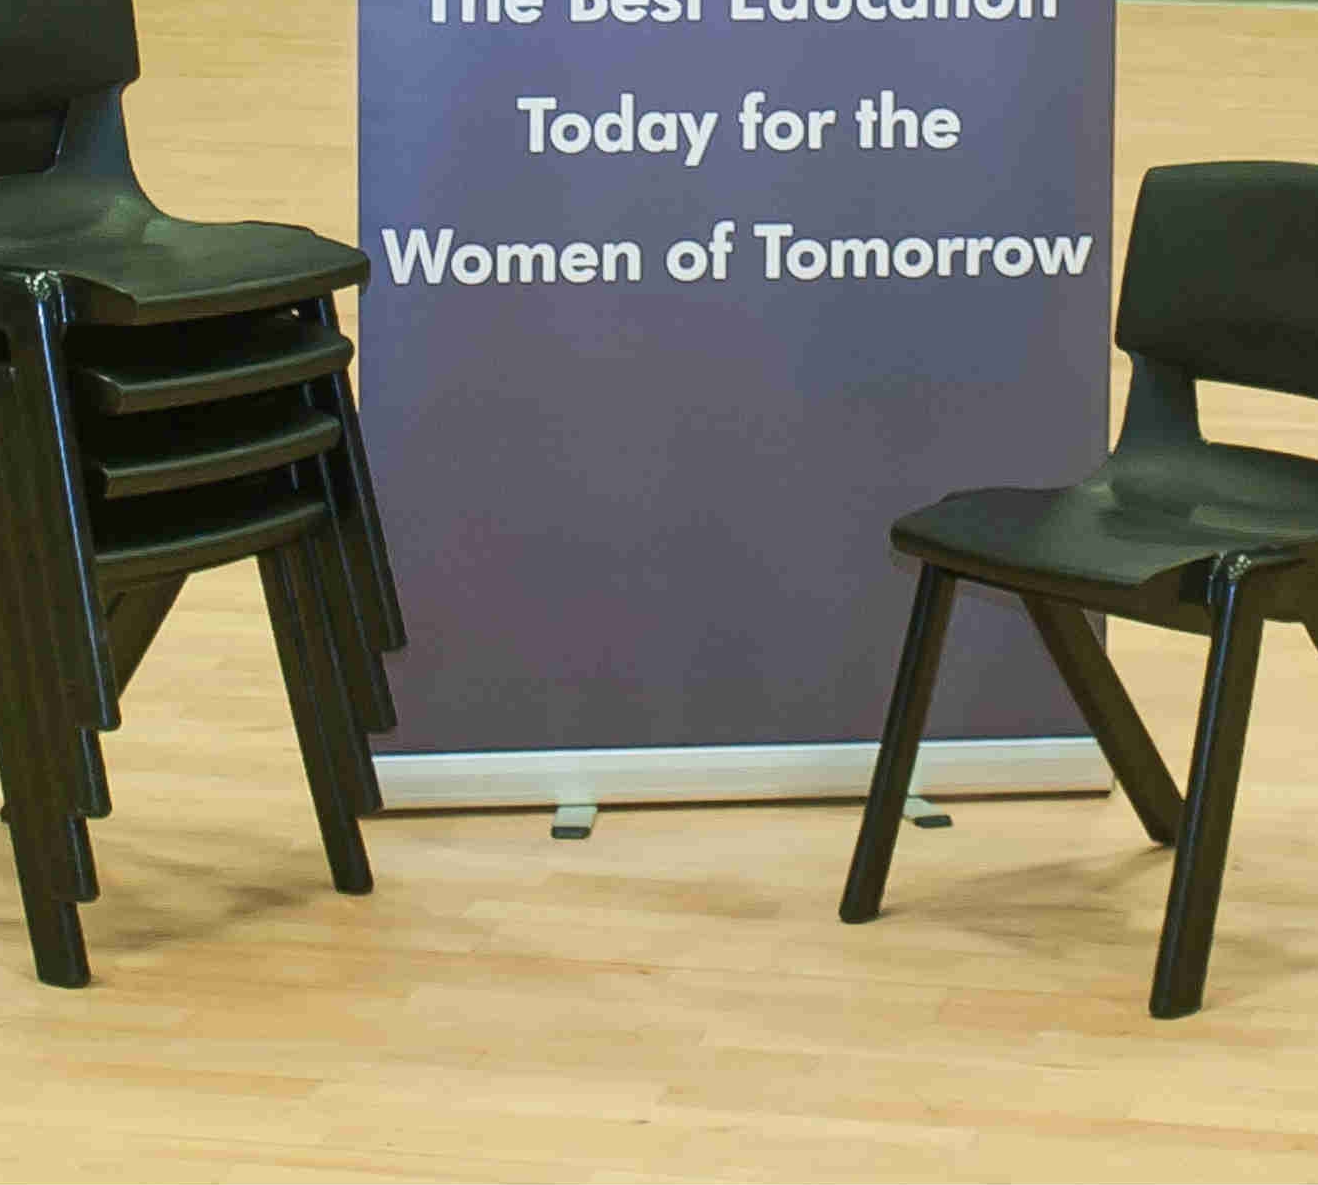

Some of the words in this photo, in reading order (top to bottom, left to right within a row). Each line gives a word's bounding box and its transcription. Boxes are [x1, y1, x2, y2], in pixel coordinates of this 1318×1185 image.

[516, 93, 718, 166] Today
[739, 90, 836, 152] for
[855, 90, 961, 149] the
[381, 228, 641, 284] Women
[666, 221, 736, 282] of
[753, 223, 1092, 280] Tomorrow
